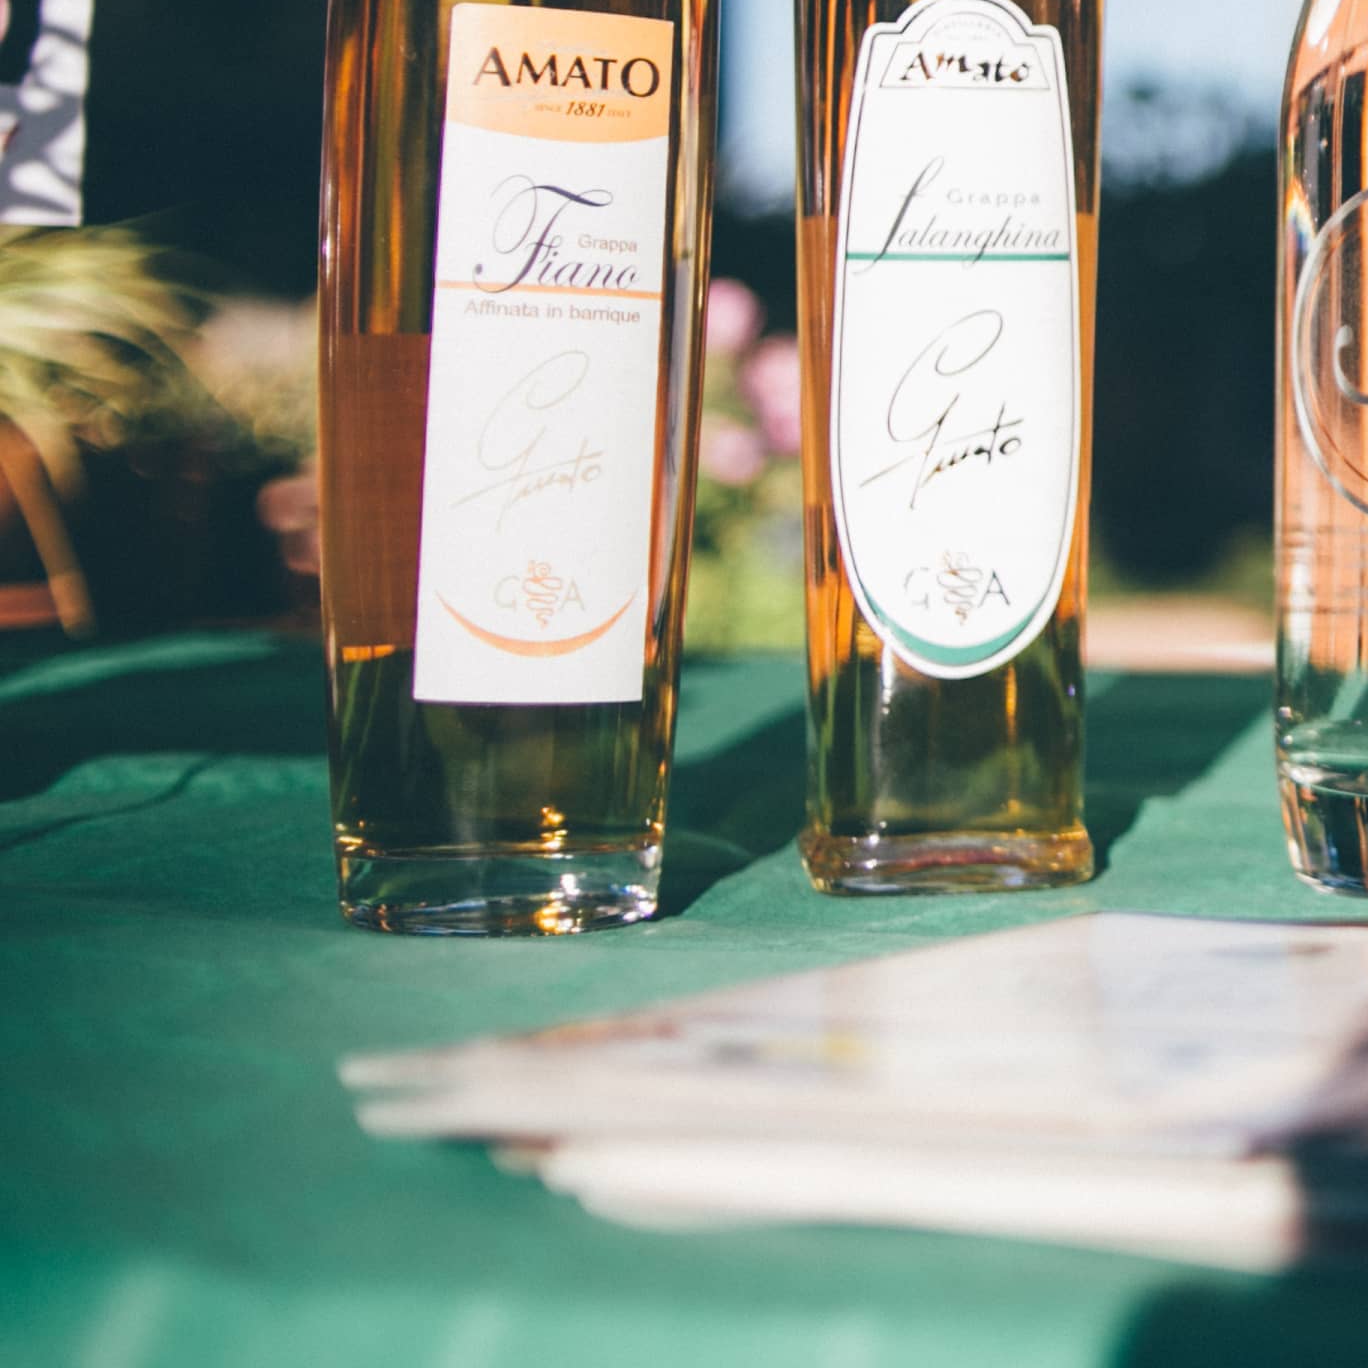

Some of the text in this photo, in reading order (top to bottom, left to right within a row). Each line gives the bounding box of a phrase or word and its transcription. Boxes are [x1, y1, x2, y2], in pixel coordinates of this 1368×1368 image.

[472, 46, 660, 98] AMATO
[900, 51, 1030, 83] Amato
[565, 101, 606, 118] 1881
[947, 188, 1041, 208] Grappa
[472, 174, 640, 292] Fiano
[578, 234, 638, 254] Grappa
[463, 298, 641, 325] Affinata in barrique
